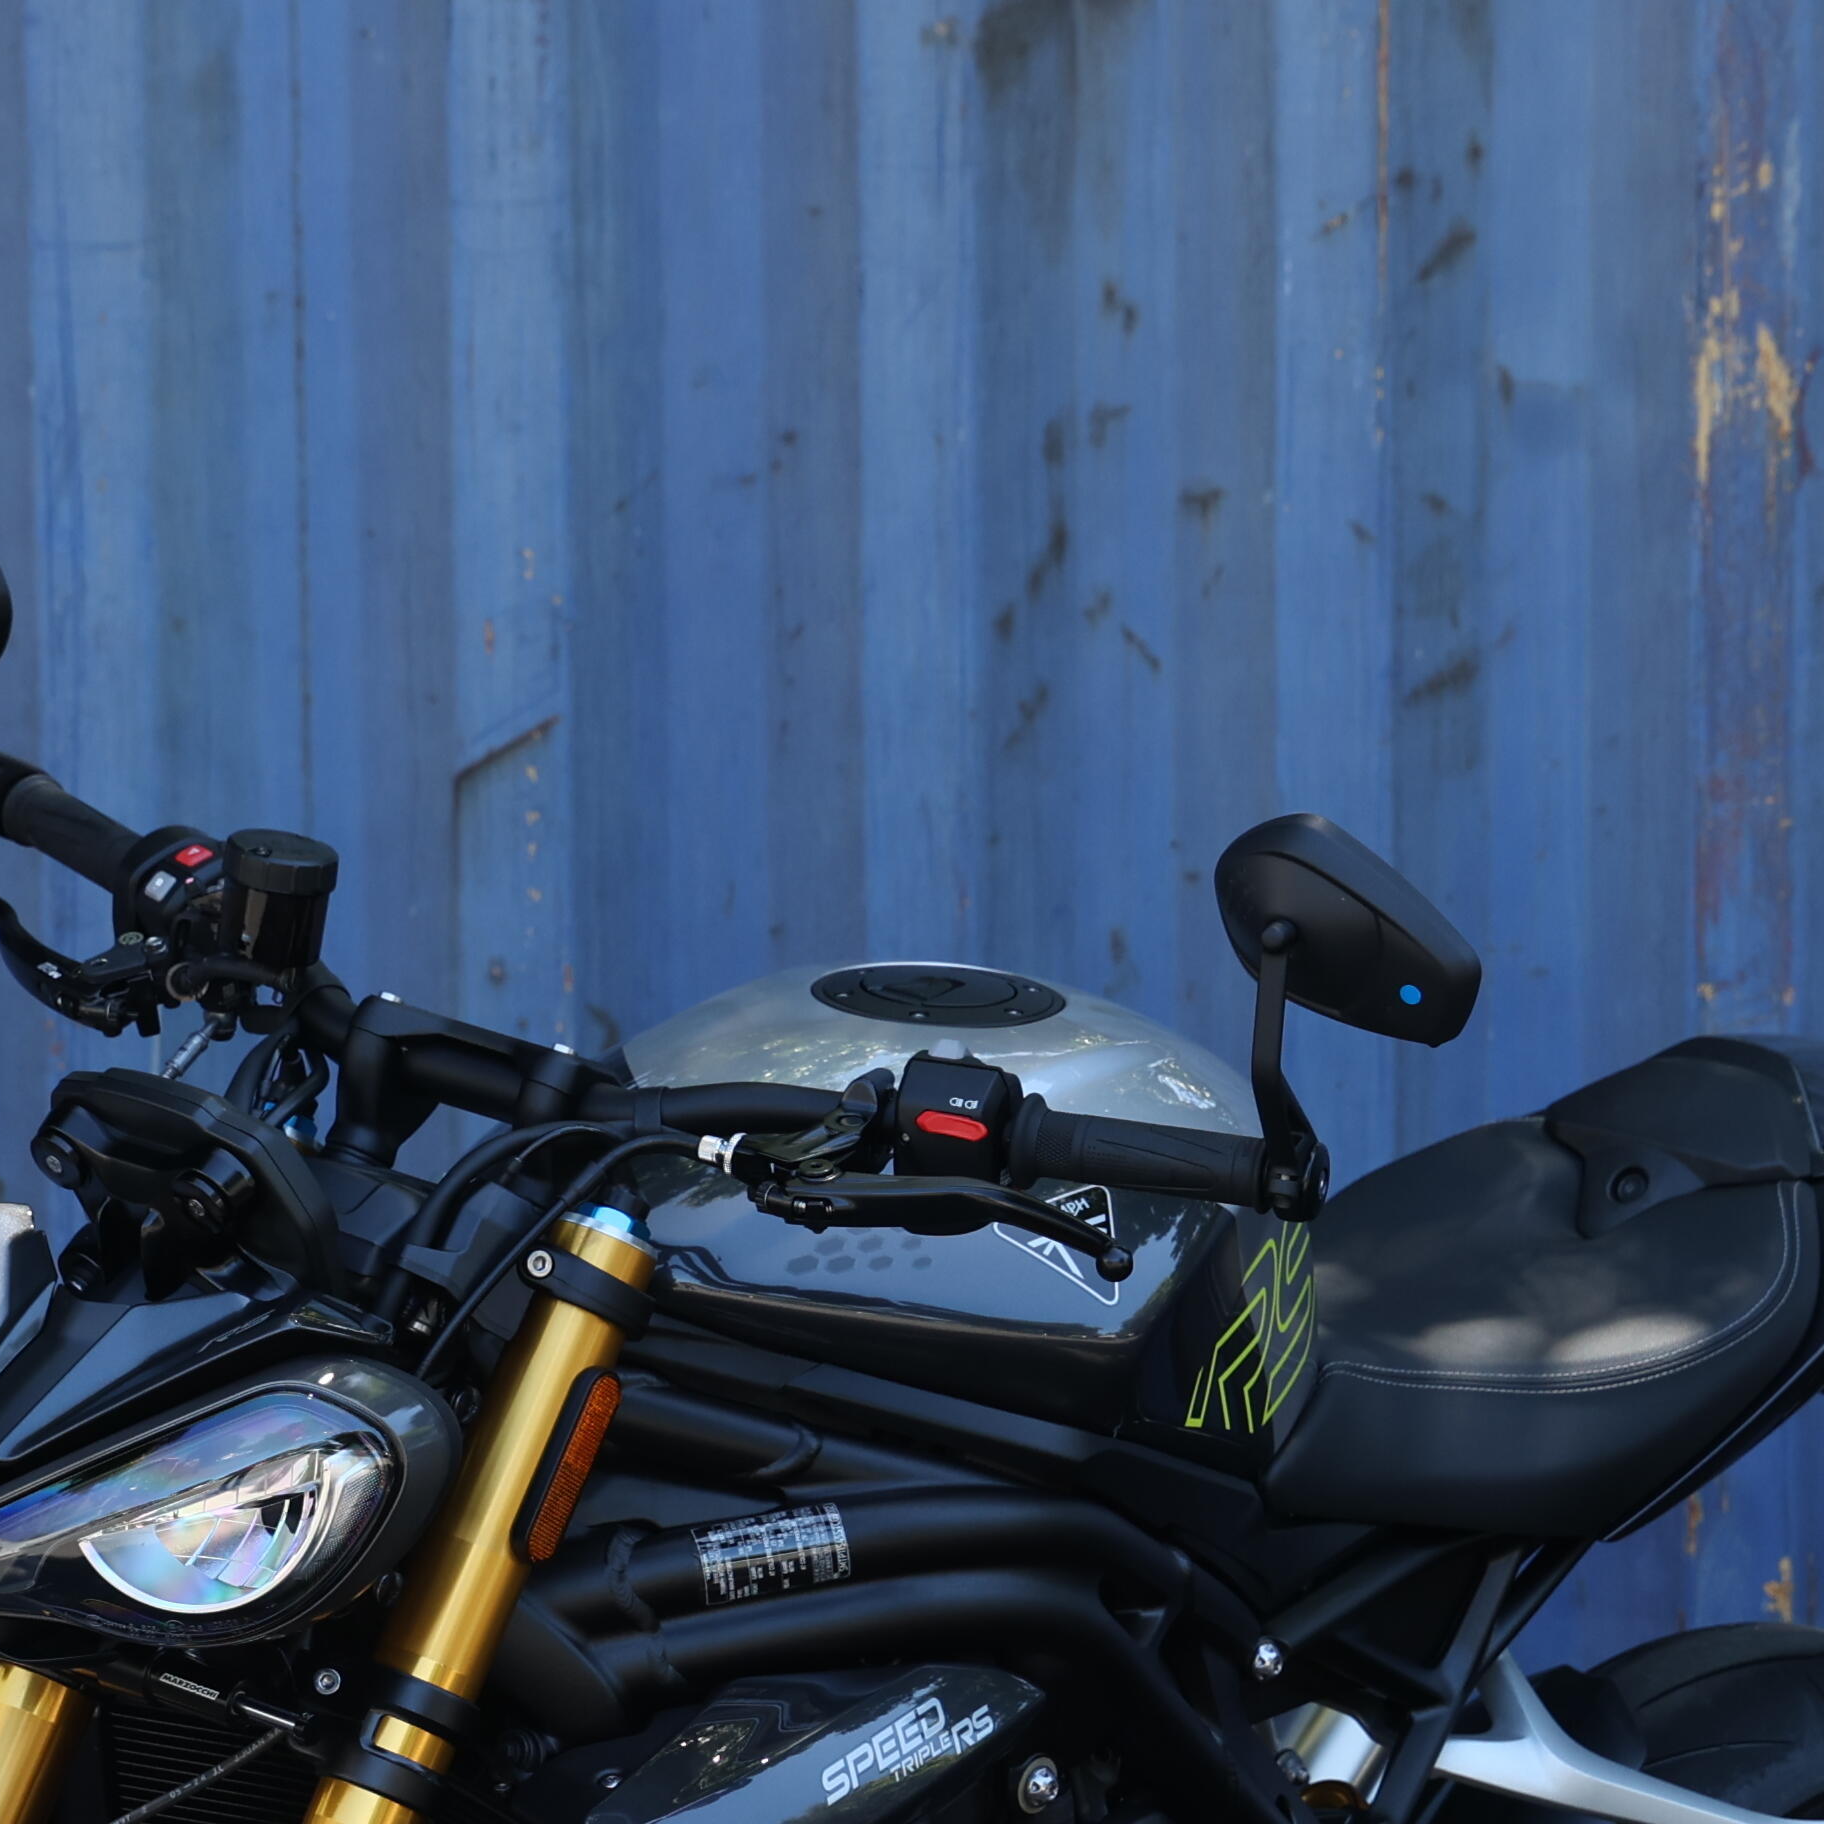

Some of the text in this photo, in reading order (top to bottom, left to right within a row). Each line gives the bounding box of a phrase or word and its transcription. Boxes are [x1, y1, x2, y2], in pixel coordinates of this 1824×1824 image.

[162, 1674, 218, 1699] MARZOCCHI
[821, 1697, 947, 1807] SPEED
[889, 1704, 995, 1783] TRIPLE RS
